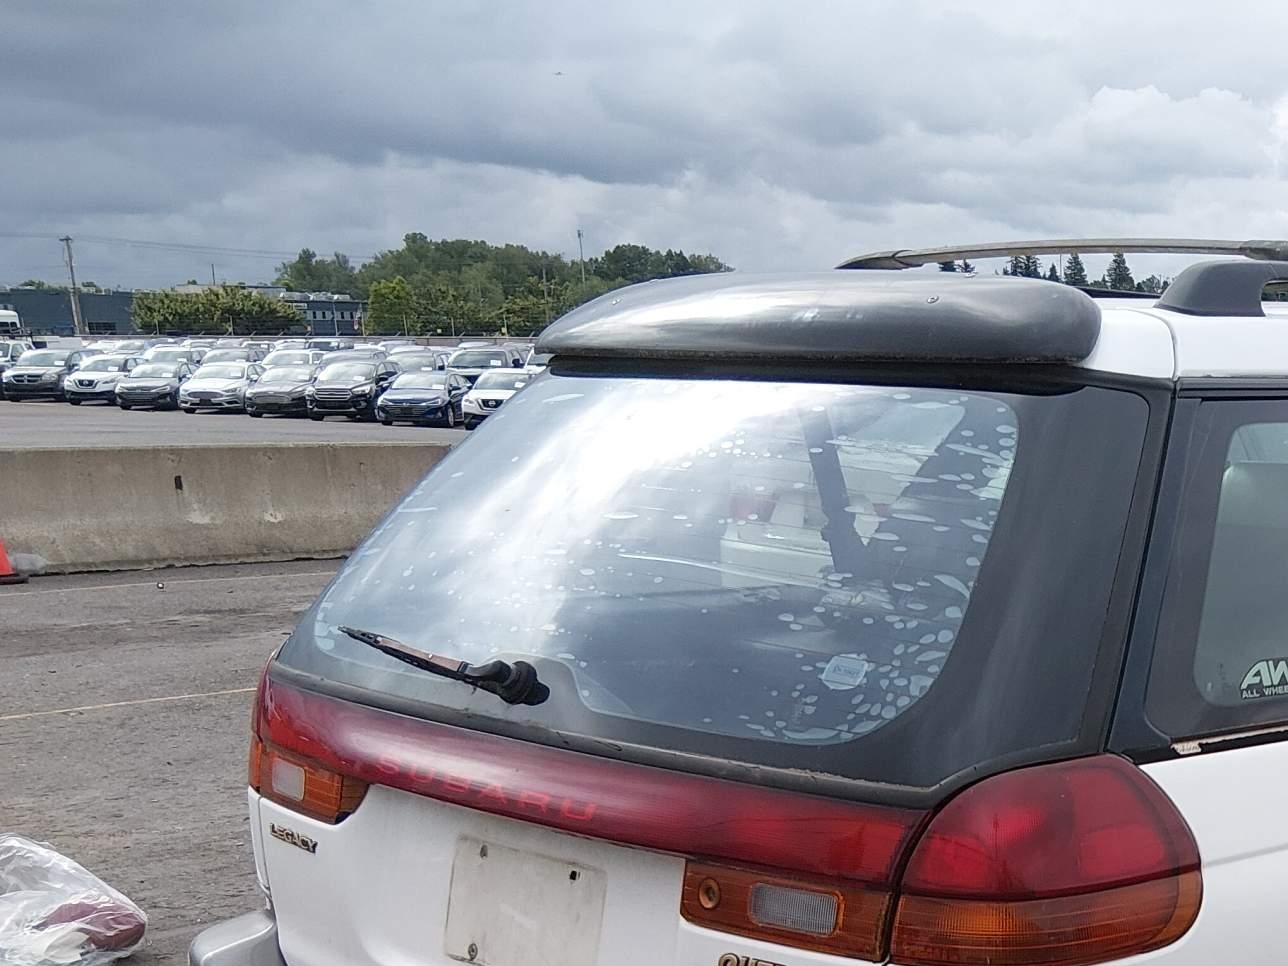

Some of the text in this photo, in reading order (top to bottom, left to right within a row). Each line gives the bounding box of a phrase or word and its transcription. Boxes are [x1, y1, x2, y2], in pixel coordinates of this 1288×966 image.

[1242, 689, 1260, 699] ALL
[376, 758, 598, 821] SUBARU
[270, 823, 318, 854] LEGACY
